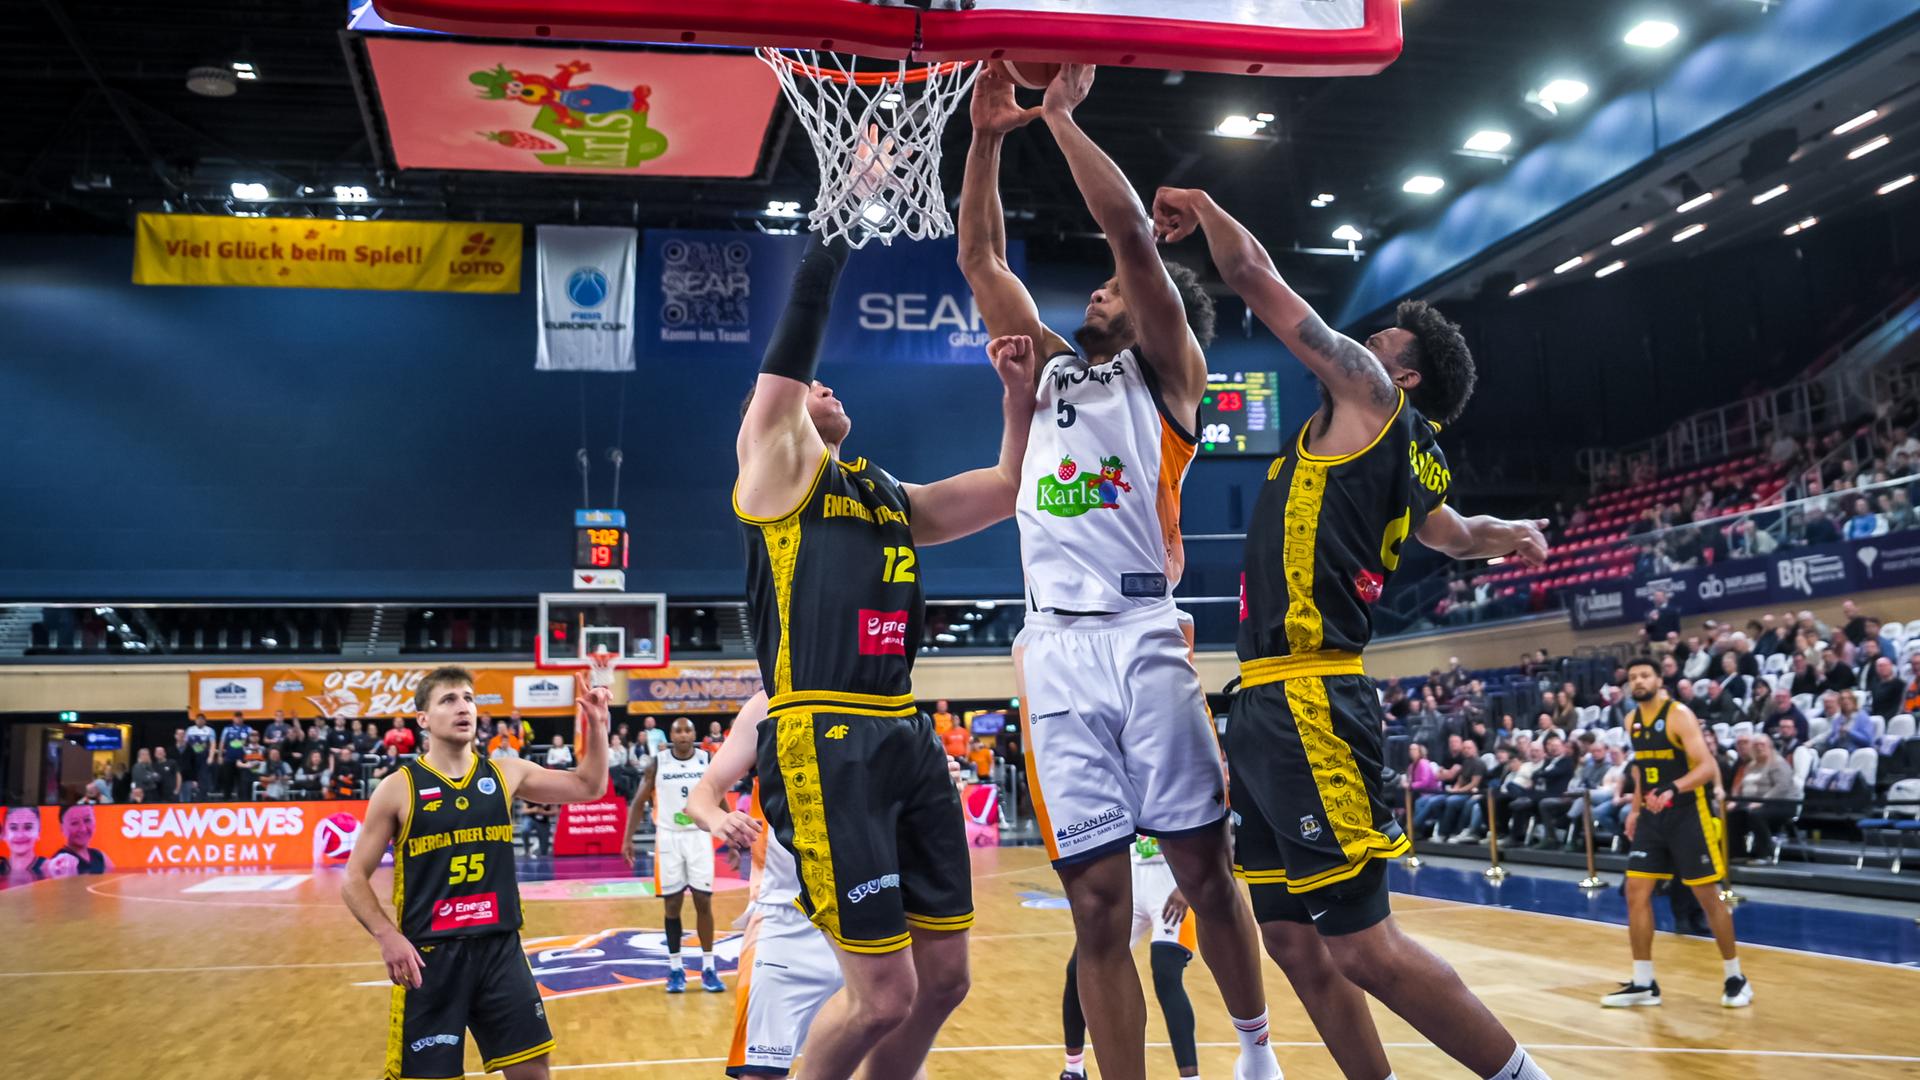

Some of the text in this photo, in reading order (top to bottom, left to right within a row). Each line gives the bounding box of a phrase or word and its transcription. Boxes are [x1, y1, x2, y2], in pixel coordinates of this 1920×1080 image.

[560, 113, 633, 167] Karls
[165, 240, 423, 267] Viel Glück beim Spiel!
[449, 260, 505, 275] LOTTO
[661, 271, 750, 298] SEAR
[545, 322, 627, 332] EUROPE CUP
[661, 328, 697, 341] Komm
[1217, 391, 1243, 412] 23
[1056, 398, 1077, 428] 5
[1039, 481, 1101, 506] Karls
[587, 529, 619, 546] 7:02
[591, 546, 611, 567] 19
[882, 546, 916, 583] 12
[825, 725, 849, 739] 4F
[681, 786, 689, 798] 9
[422, 800, 443, 812] 4F
[121, 807, 304, 839] SEAWOLVES
[1067, 818, 1098, 834] SCAN
[408, 824, 513, 857] ENERGA TREFL SOPOT
[147, 843, 276, 863] ACADEMY
[448, 853, 485, 885] 55
[455, 900, 492, 912] Energa
